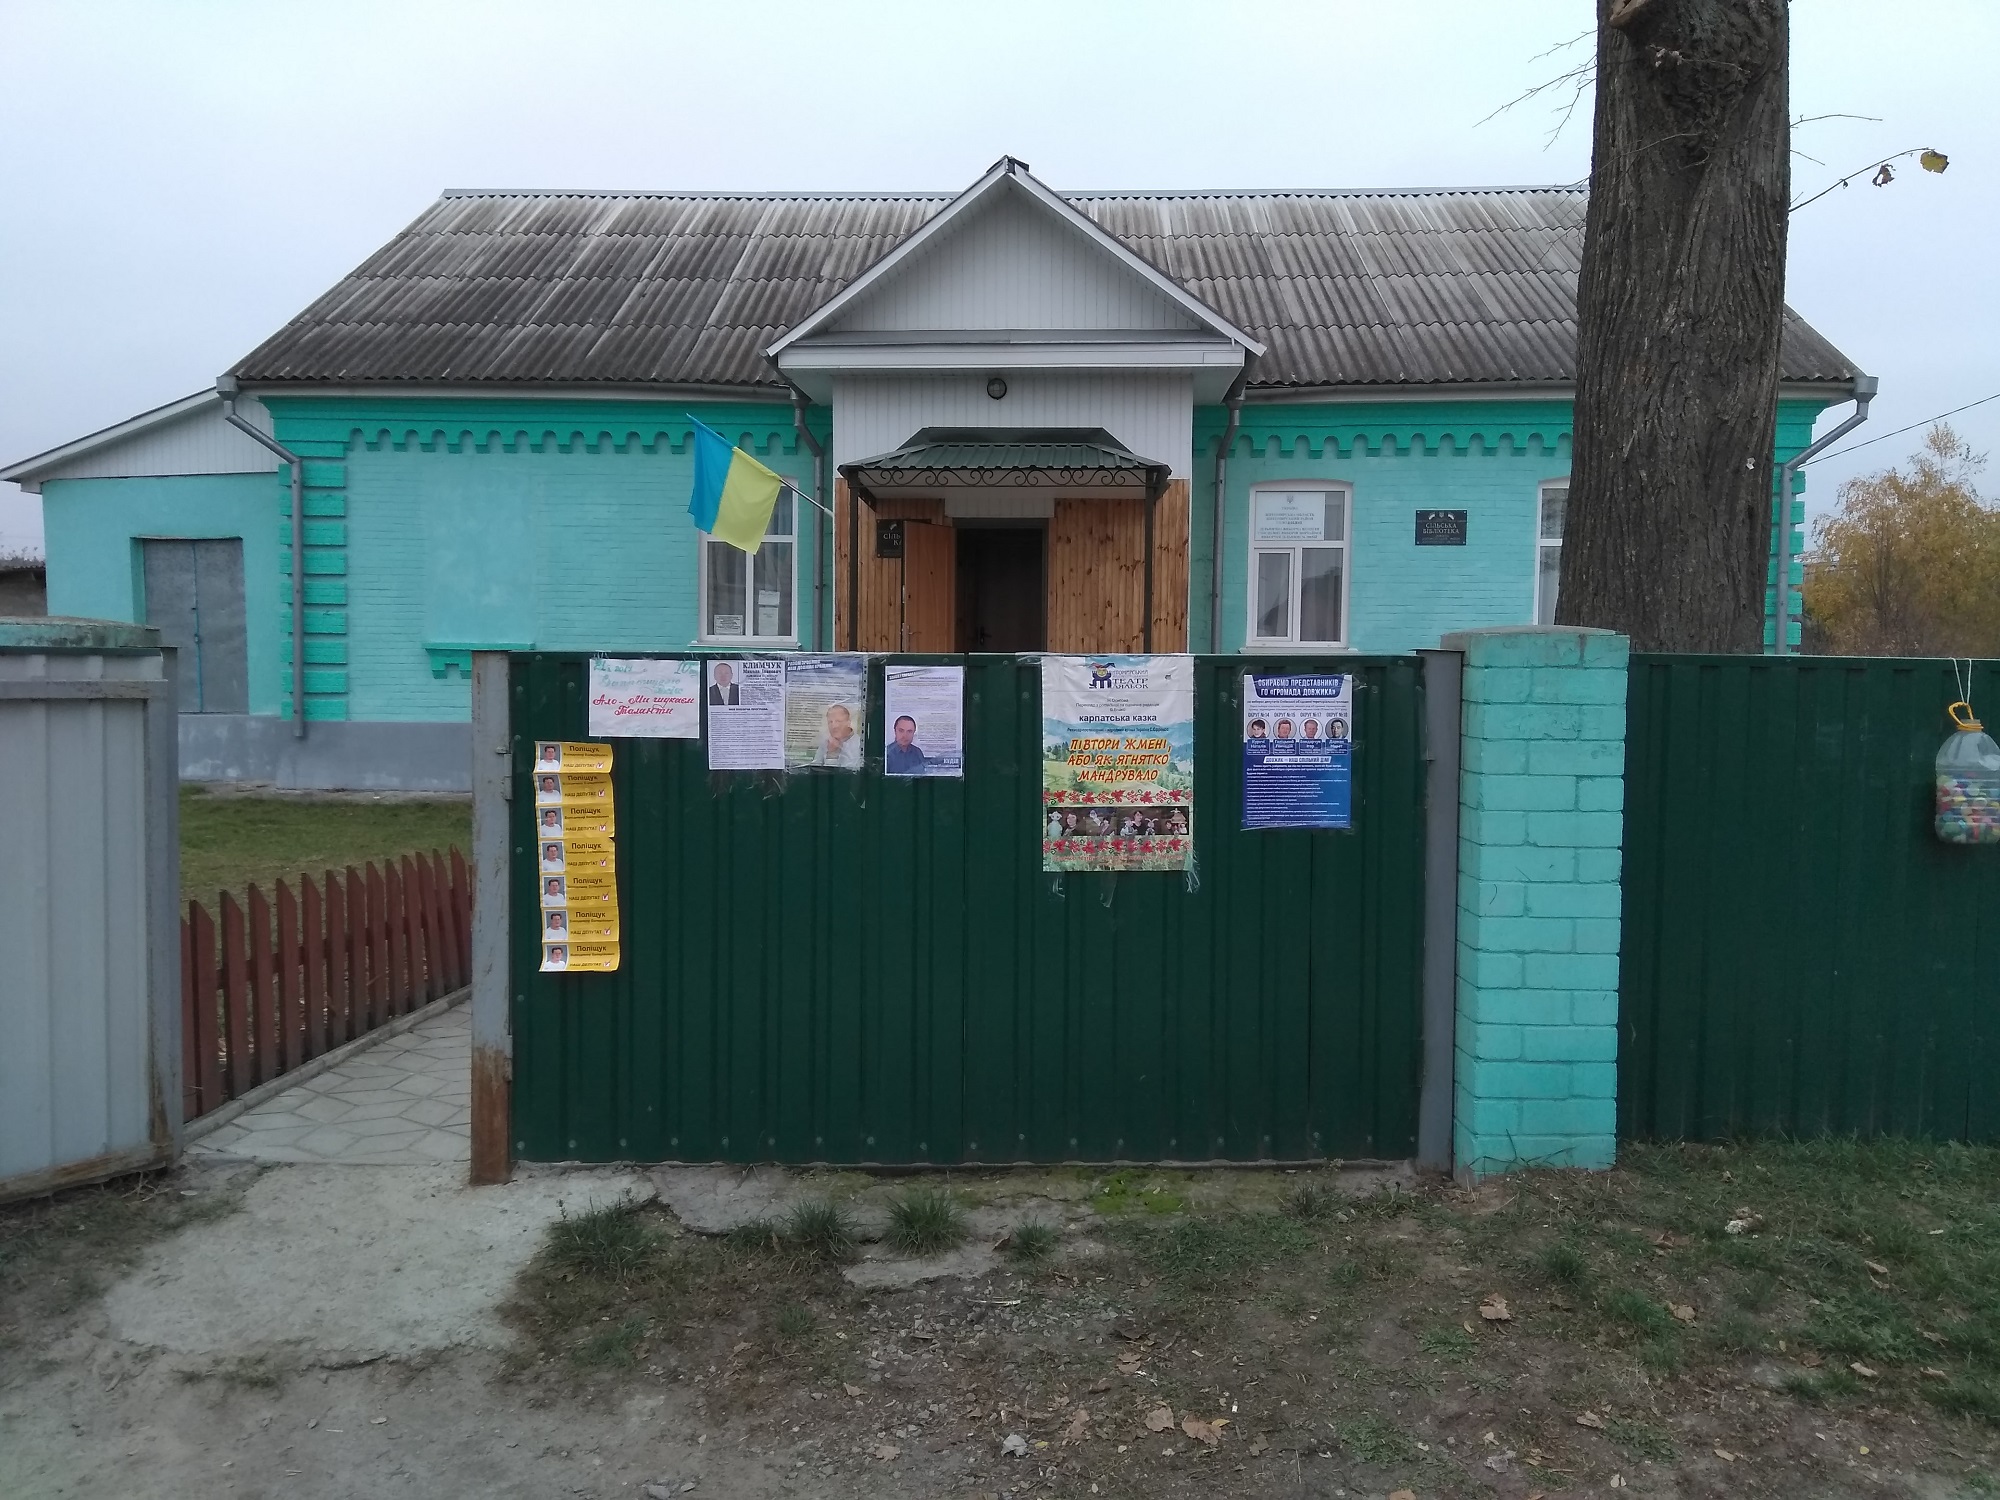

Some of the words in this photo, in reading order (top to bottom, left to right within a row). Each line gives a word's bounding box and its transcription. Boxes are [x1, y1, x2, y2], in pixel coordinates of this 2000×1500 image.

[1291, 679, 1339, 687] ПРЕДСТАВНИКІВ
[1070, 740, 1120, 750] ПІВТОРИ
[1124, 739, 1171, 752] ЖМЕНІ,
[1068, 755, 1091, 765] АБО
[1095, 755, 1113, 765] ЯК
[1116, 754, 1169, 765] ЯГНЯТКО
[1078, 770, 1158, 782] МАНДРУВАЛО
